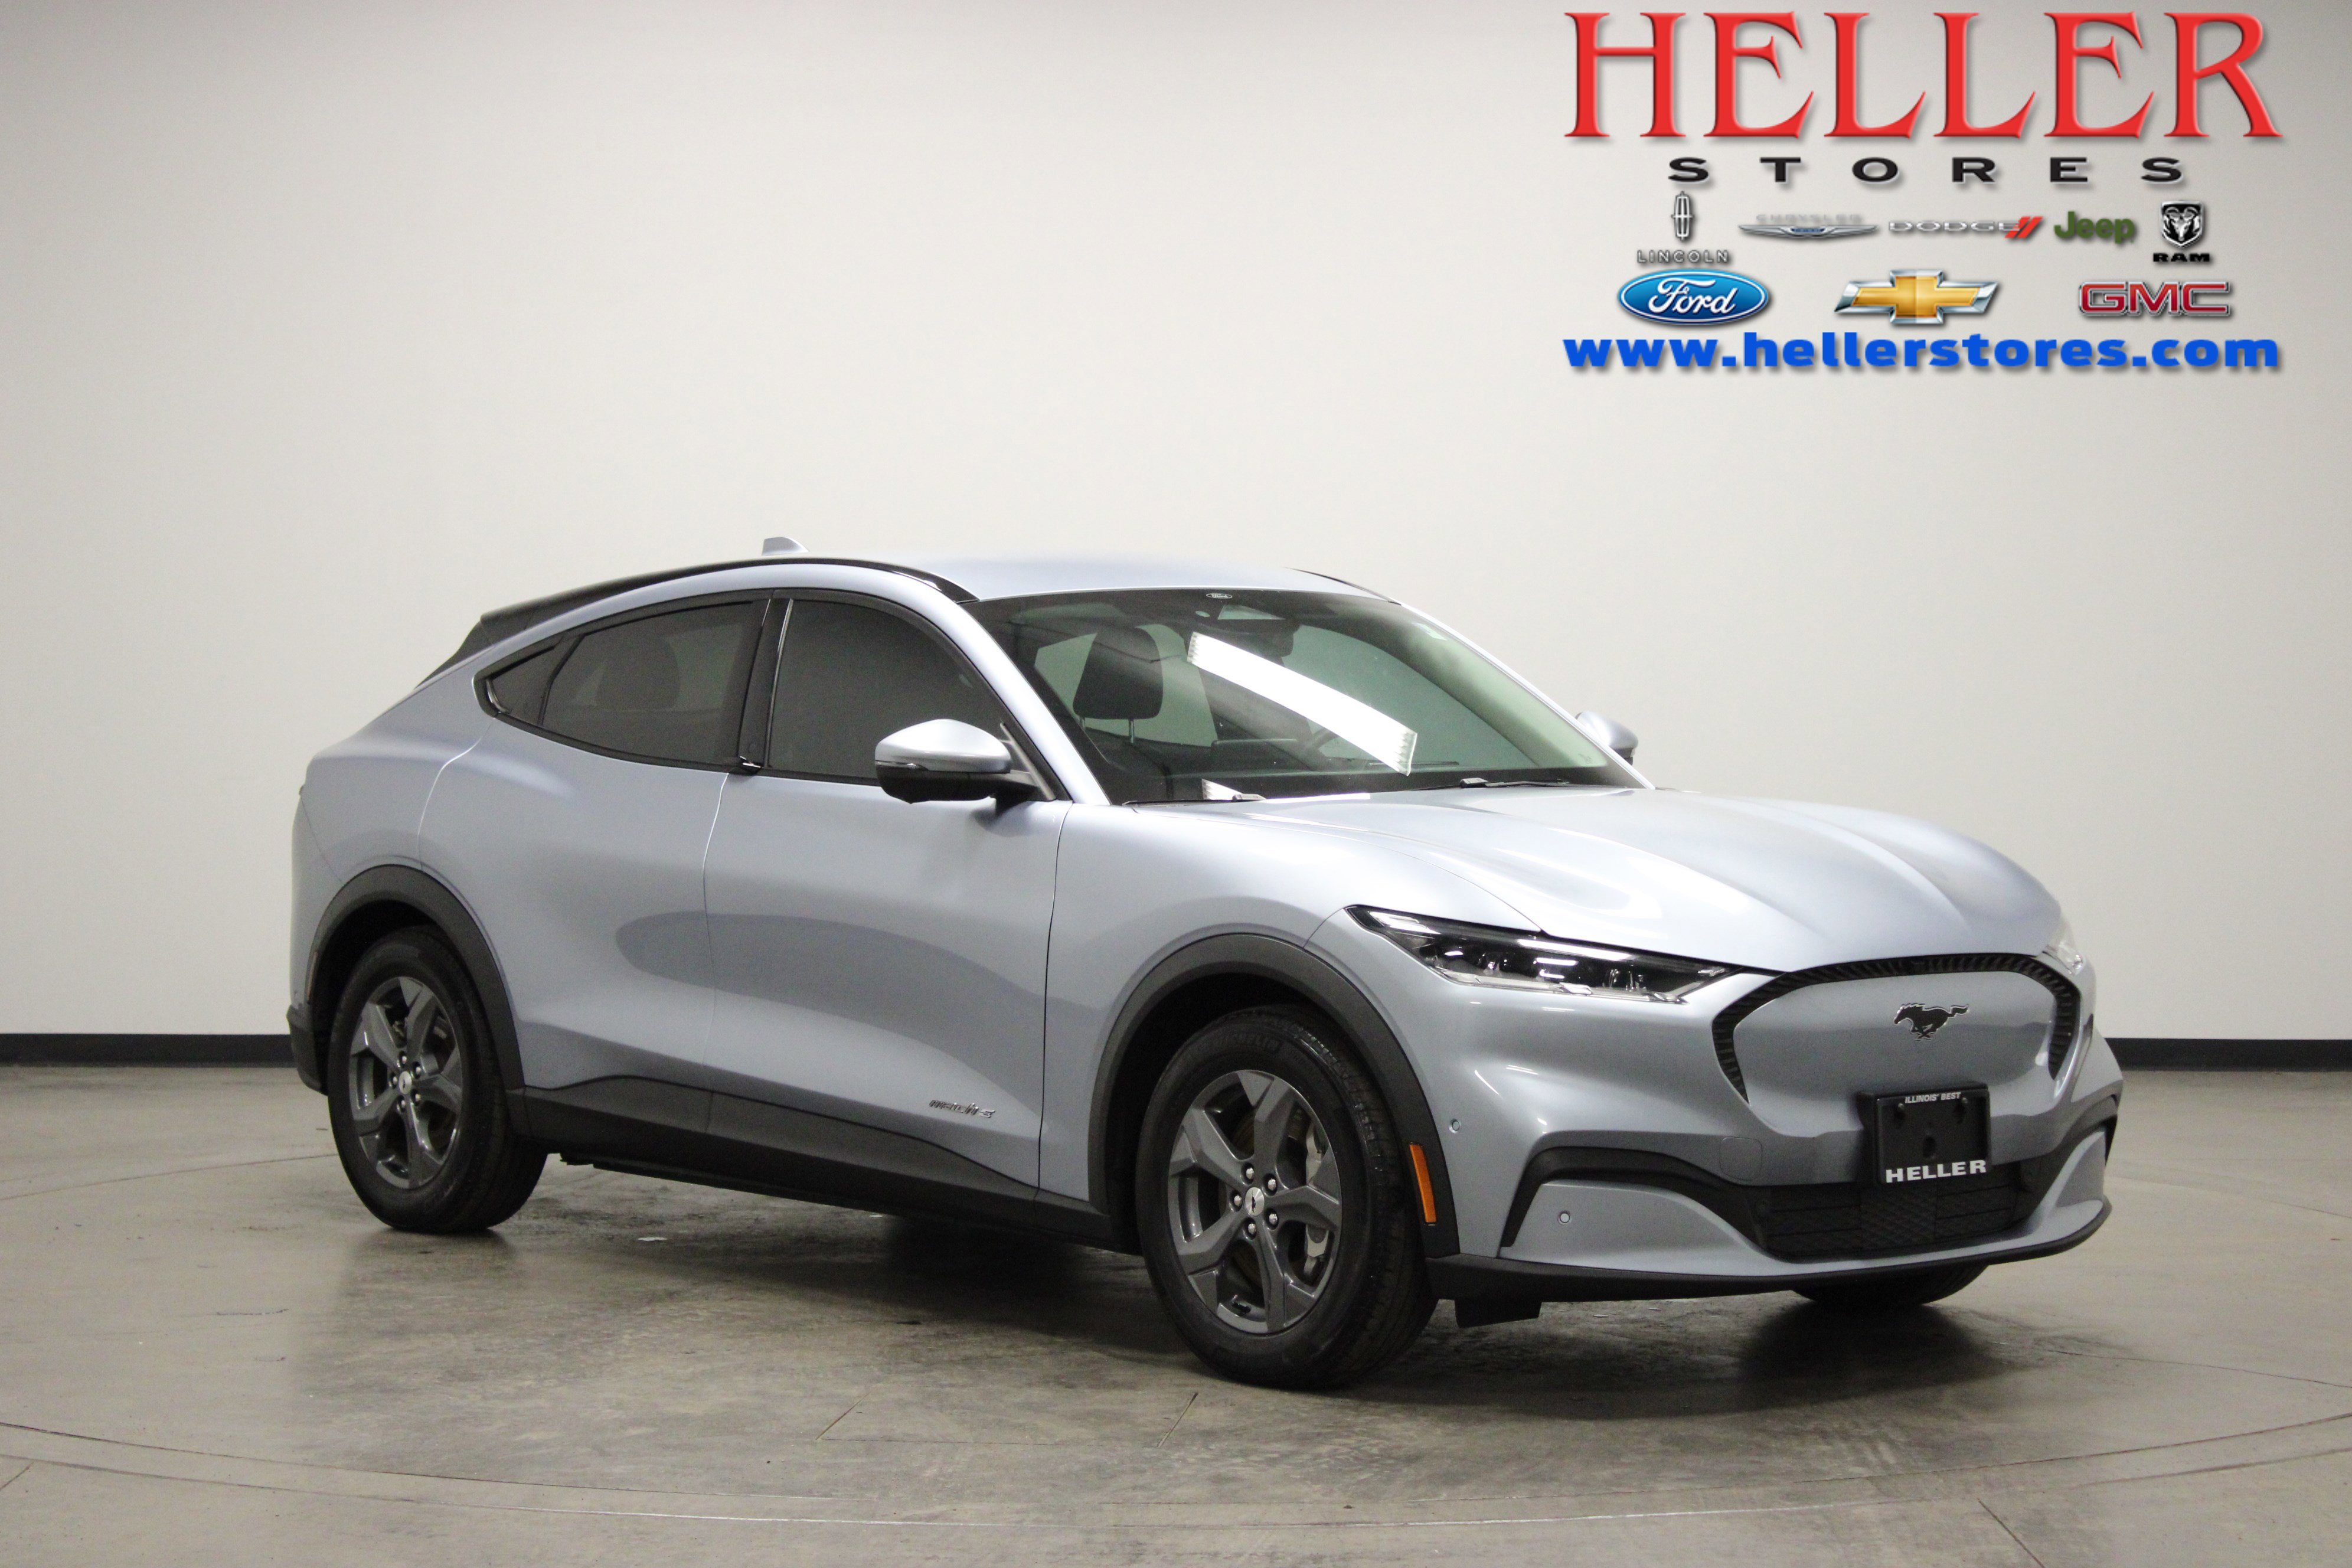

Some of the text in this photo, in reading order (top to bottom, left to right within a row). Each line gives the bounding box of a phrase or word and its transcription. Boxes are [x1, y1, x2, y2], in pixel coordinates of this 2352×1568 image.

[1905, 1092, 1961, 1103] ILLINOIS' BEST
[1886, 1159, 1987, 1183] HELLER
